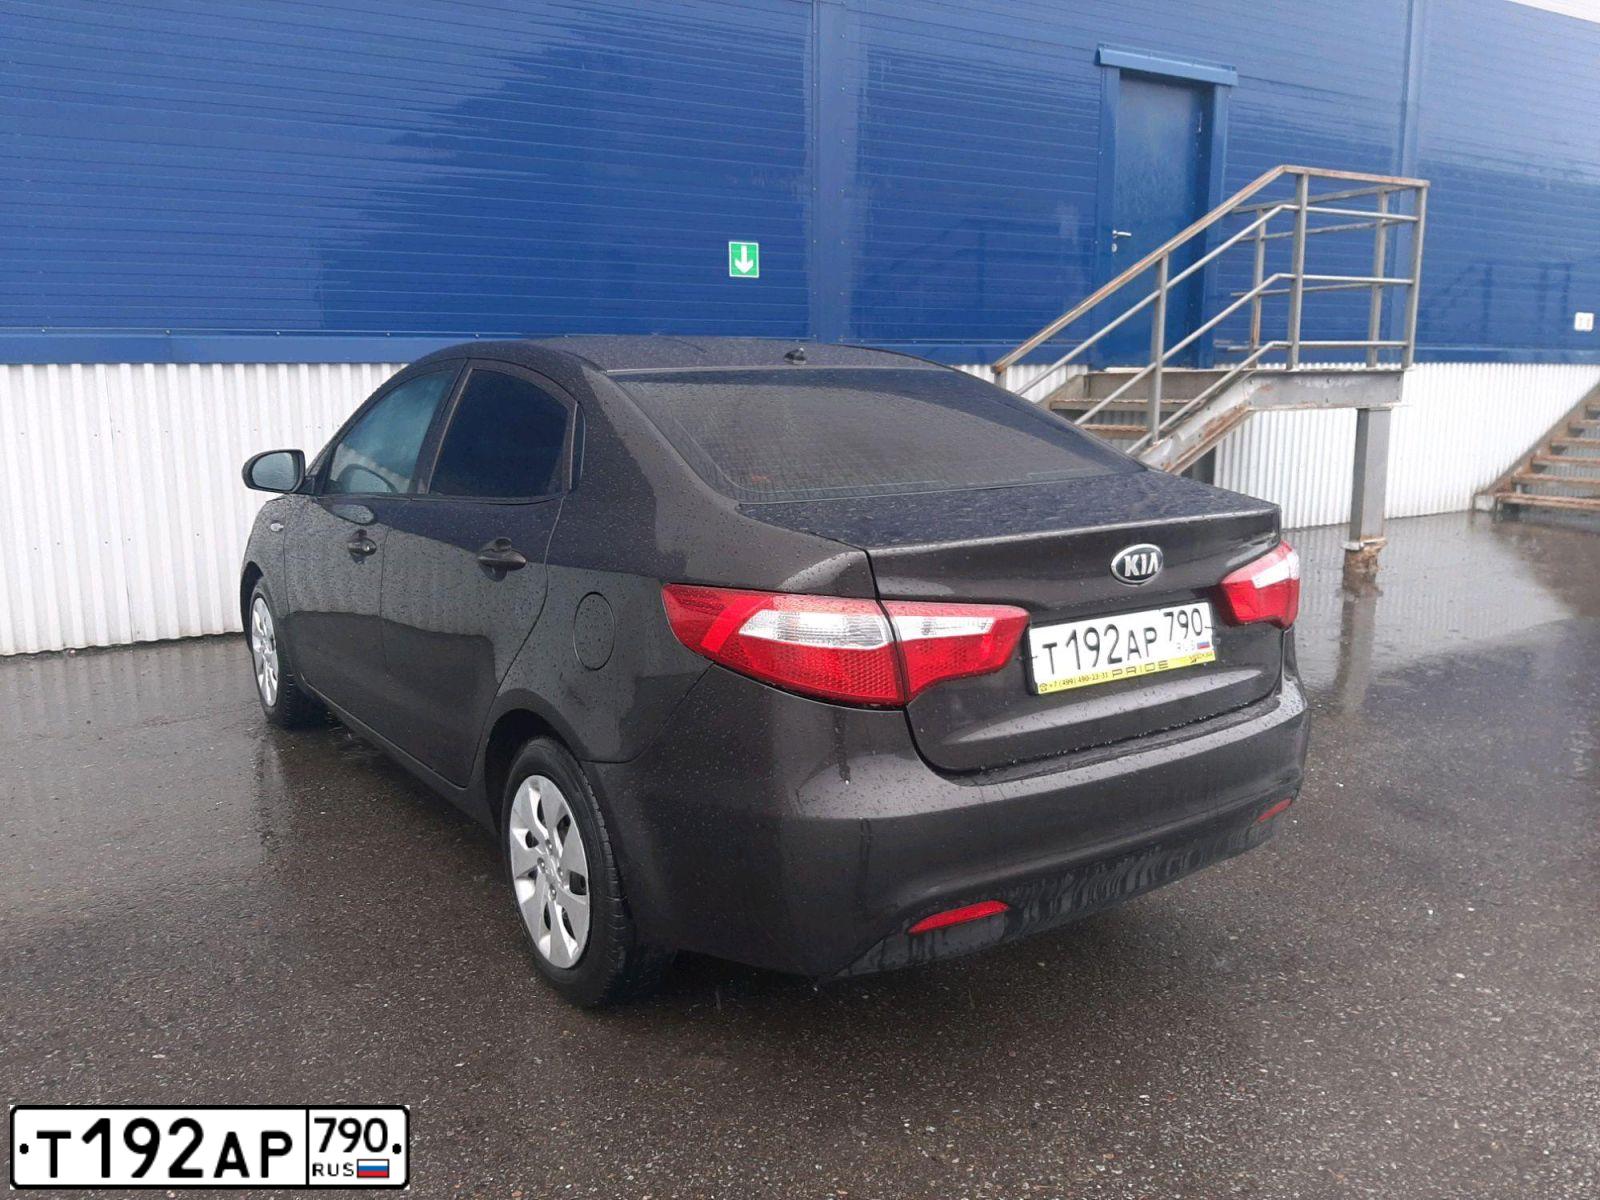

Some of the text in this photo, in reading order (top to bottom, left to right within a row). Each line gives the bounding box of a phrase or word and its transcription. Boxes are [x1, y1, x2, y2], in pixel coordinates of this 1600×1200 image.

[1124, 552, 1159, 577] KIA
[1163, 607, 1203, 642] 790
[1111, 659, 1169, 678] PRIDE
